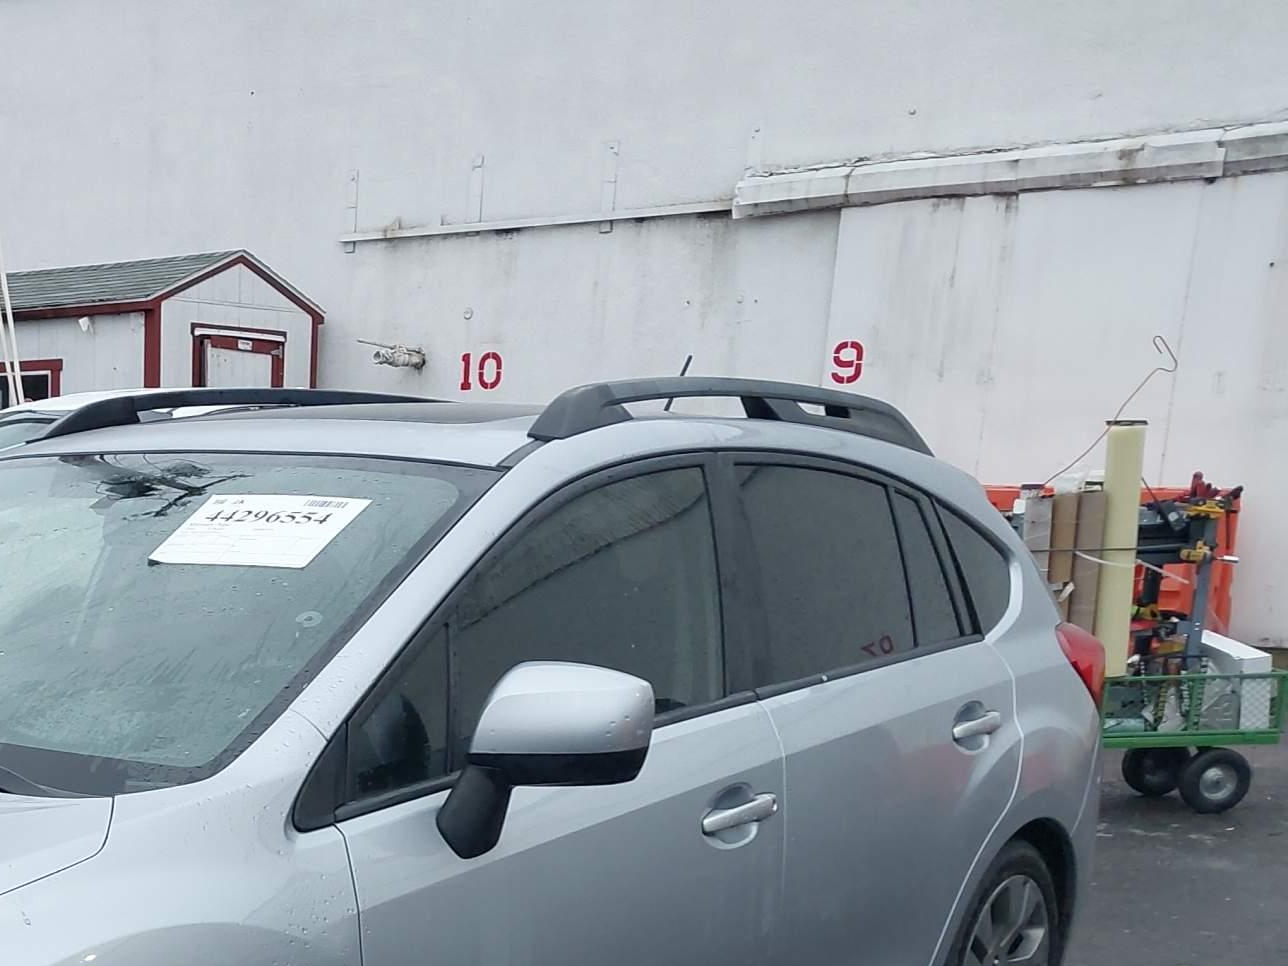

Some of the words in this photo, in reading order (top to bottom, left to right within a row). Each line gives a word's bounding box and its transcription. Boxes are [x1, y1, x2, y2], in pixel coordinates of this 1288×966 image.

[460, 352, 502, 390] 10
[831, 341, 863, 384] 9
[204, 509, 334, 525] 44296554
